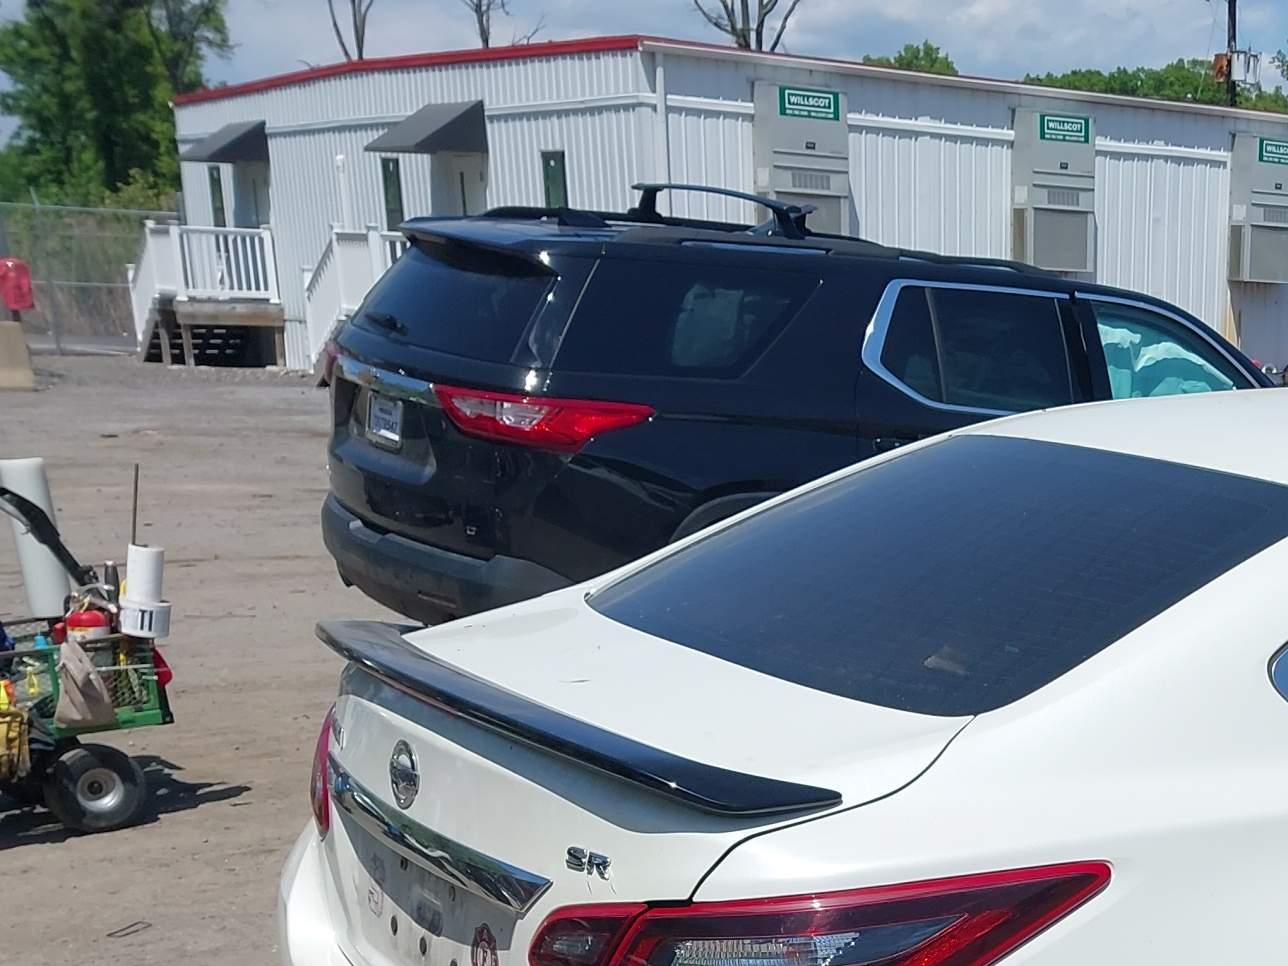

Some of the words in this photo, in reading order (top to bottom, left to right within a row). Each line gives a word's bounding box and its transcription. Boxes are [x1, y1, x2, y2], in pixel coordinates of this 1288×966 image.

[789, 95, 830, 107] WILLSCOT
[1048, 120, 1082, 131] WILLSCOT
[566, 846, 611, 881] SR
